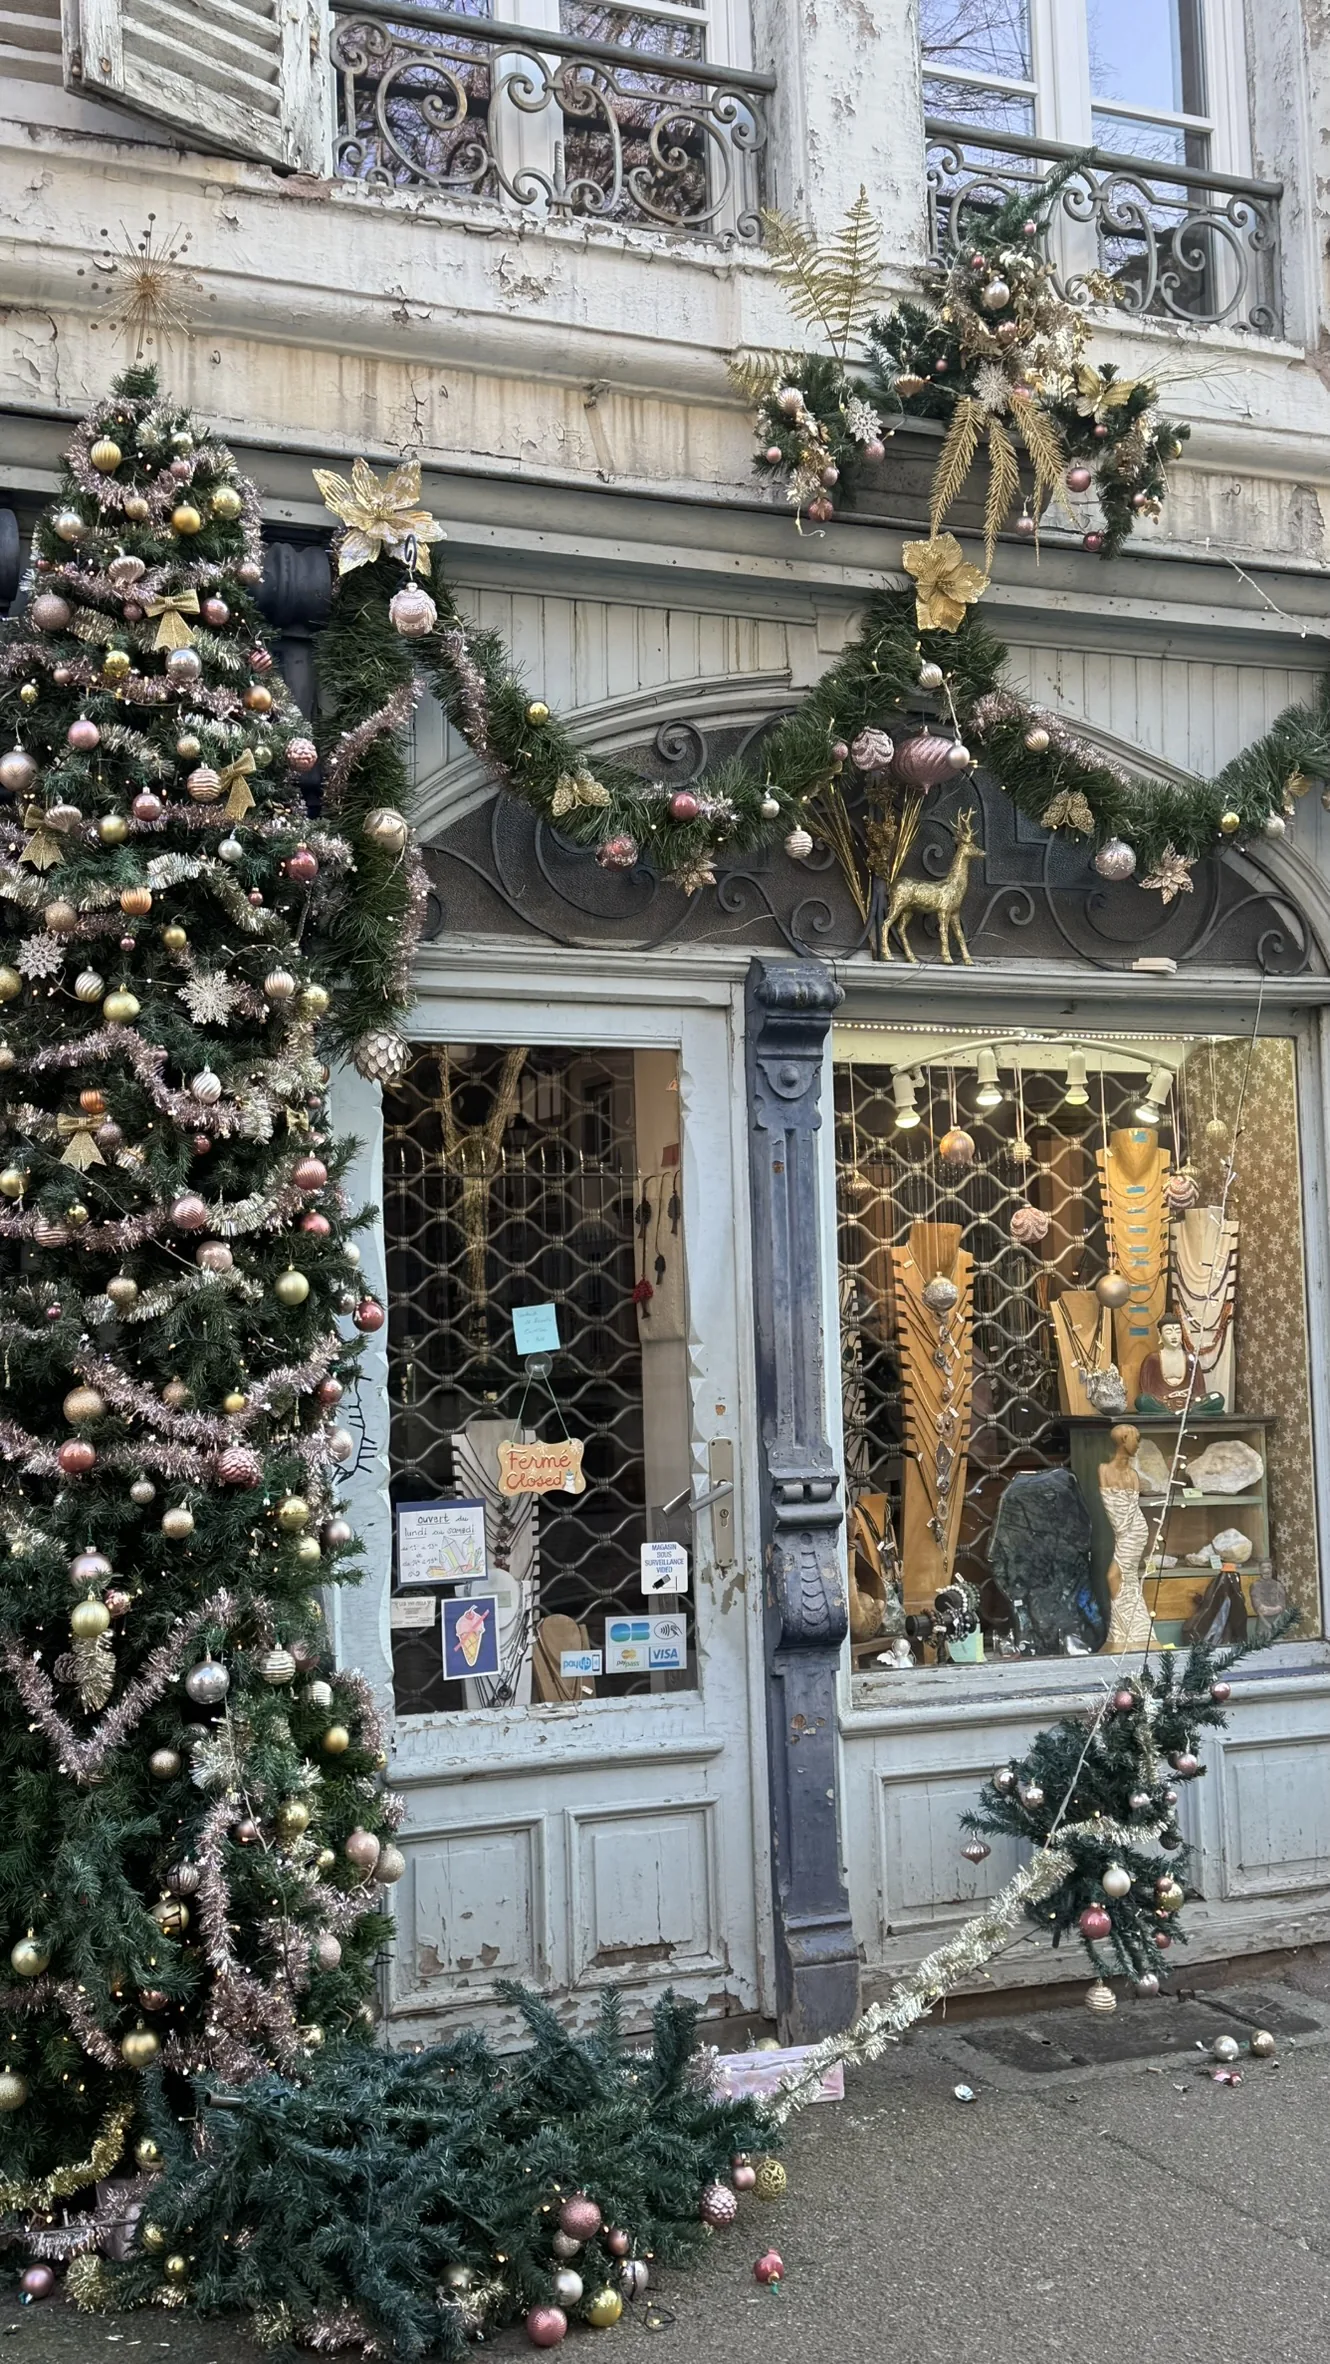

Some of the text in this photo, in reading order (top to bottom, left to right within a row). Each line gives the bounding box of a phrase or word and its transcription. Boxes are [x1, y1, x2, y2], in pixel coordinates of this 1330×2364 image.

[507, 1449, 571, 1470] Fermé
[507, 1470, 562, 1490] Closed
[417, 1513, 450, 1524] ouvert
[404, 1527, 427, 1537] lundi
[447, 1524, 475, 1535] samedi
[645, 1558, 684, 1567] SURVEILLANCE
[653, 1648, 678, 1660] VISA
